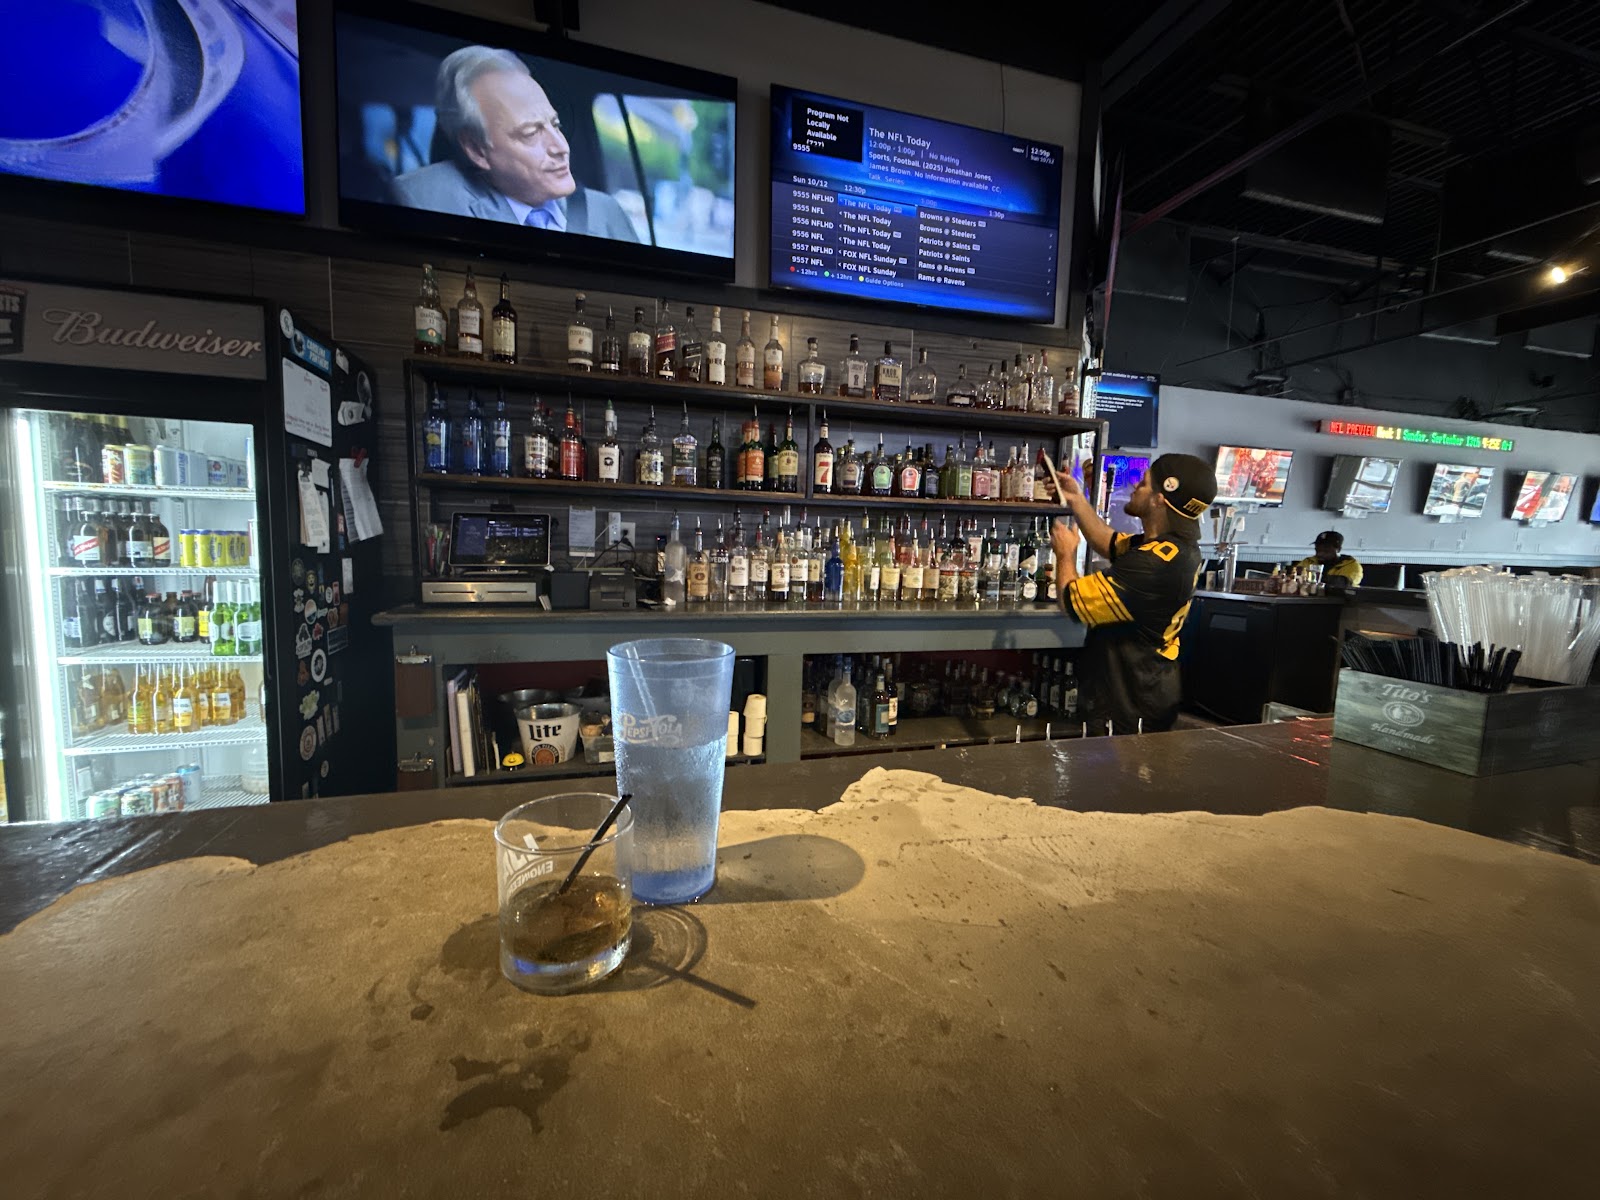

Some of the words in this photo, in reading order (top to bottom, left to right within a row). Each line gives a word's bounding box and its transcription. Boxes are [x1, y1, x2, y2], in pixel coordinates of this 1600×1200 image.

[806, 107, 836, 120] Program
[836, 114, 849, 123] Not
[806, 118, 830, 131] Locally
[806, 129, 837, 141] Available
[869, 128, 885, 138] The
[888, 132, 904, 143] NFL
[907, 135, 931, 150] Today
[792, 142, 810, 152] 9555
[929, 152, 938, 160] No
[940, 154, 960, 166] Rating
[868, 152, 892, 162] Sports,
[922, 162, 943, 172] (2025)
[945, 166, 972, 178] Jonathan
[974, 172, 993, 182] Jones,
[869, 162, 889, 172] James
[792, 190, 810, 199] 9555
[812, 193, 834, 203] NFLHD
[792, 176, 806, 184] Sun
[808, 178, 828, 188] 10/12
[844, 185, 866, 194] 12:30p
[988, 210, 1004, 220] 1:30p
[792, 204, 810, 212] 9555
[812, 206, 824, 214] NFL
[844, 198, 856, 207] The
[858, 201, 871, 210] NFL
[874, 202, 892, 214] Today
[792, 216, 810, 225] 9556
[811, 220, 834, 229] NFLHD
[844, 212, 856, 220] The
[858, 214, 871, 222] NFL
[873, 216, 892, 227] Today
[920, 212, 942, 222] Browns
[952, 216, 976, 227] Steelers
[792, 230, 809, 238] 9556
[811, 232, 824, 240] NFL
[844, 224, 856, 232] The
[858, 226, 870, 235] NFL
[872, 228, 891, 240] Today
[920, 224, 942, 234] Browns
[952, 230, 976, 240] Steelers
[792, 243, 808, 251] 9557
[810, 246, 834, 254] NFLHD
[843, 237, 856, 246] The
[858, 240, 870, 248] NFL
[872, 242, 891, 252] Today
[919, 236, 944, 246] Patriots
[952, 242, 970, 251] Saints
[792, 256, 808, 264] 9557
[843, 250, 856, 258] FOX
[858, 252, 872, 261] NFL
[874, 254, 897, 266] Sunday
[918, 249, 943, 258] Patriots
[952, 254, 970, 263] Saints
[842, 262, 856, 271] FOX
[858, 265, 872, 274] NFL
[873, 267, 896, 278] Sunday
[918, 261, 936, 270] Rams
[944, 265, 966, 274] Ravens
[882, 280, 904, 288] Options
[918, 274, 935, 282] Rams
[944, 277, 966, 286] Ravens
[42, 308, 262, 358] Budweiser
[1330, 421, 1344, 434] NFL
[1346, 423, 1376, 437] PREVIEW
[818, 462, 830, 483] 7
[1382, 684, 1433, 704] Tito's
[528, 724, 562, 742] Lite
[1370, 722, 1436, 745] Handmade
